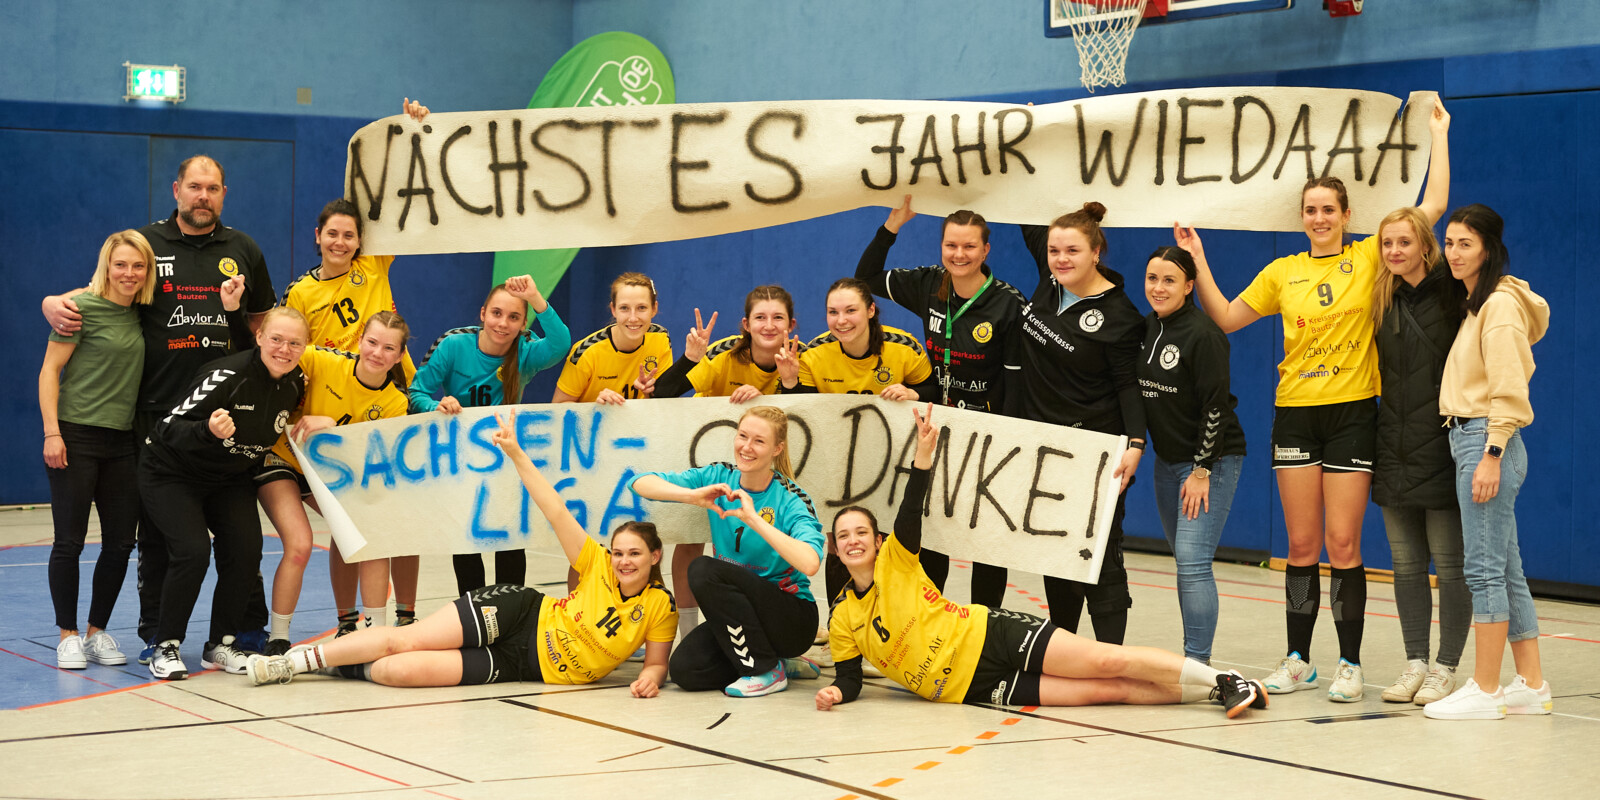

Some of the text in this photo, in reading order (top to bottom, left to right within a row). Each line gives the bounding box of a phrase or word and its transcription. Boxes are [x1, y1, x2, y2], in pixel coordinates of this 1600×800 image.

[350, 95, 1418, 231] NÄCHSTES JAHR WIEDAAA
[157, 263, 174, 277] TR
[1317, 283, 1334, 306] 9
[170, 309, 213, 326] Taylor
[332, 298, 360, 328] 13
[929, 316, 942, 333] ML
[1309, 307, 1364, 325] Kreissparkasse
[1022, 322, 1047, 346] Bautzen
[1027, 313, 1075, 352] Kreissparkasse
[1311, 322, 1341, 334] Bautzen
[1346, 340, 1361, 350] Air
[468, 385, 491, 406] 16
[970, 380, 987, 390] Air
[305, 408, 646, 492] SACHSEN-
[826, 404, 1109, 560] DANKE!
[470, 467, 649, 541] LIGA
[734, 526, 745, 553] 1
[595, 606, 622, 639] 14
[872, 616, 890, 643] 6
[574, 629, 596, 653] Bautzen
[580, 623, 621, 660] Kreissparkasse
[887, 616, 916, 664] Kreissparkasse
[929, 635, 943, 655] Air
[894, 643, 911, 670] Bautzen
[582, 670, 600, 681] Air
